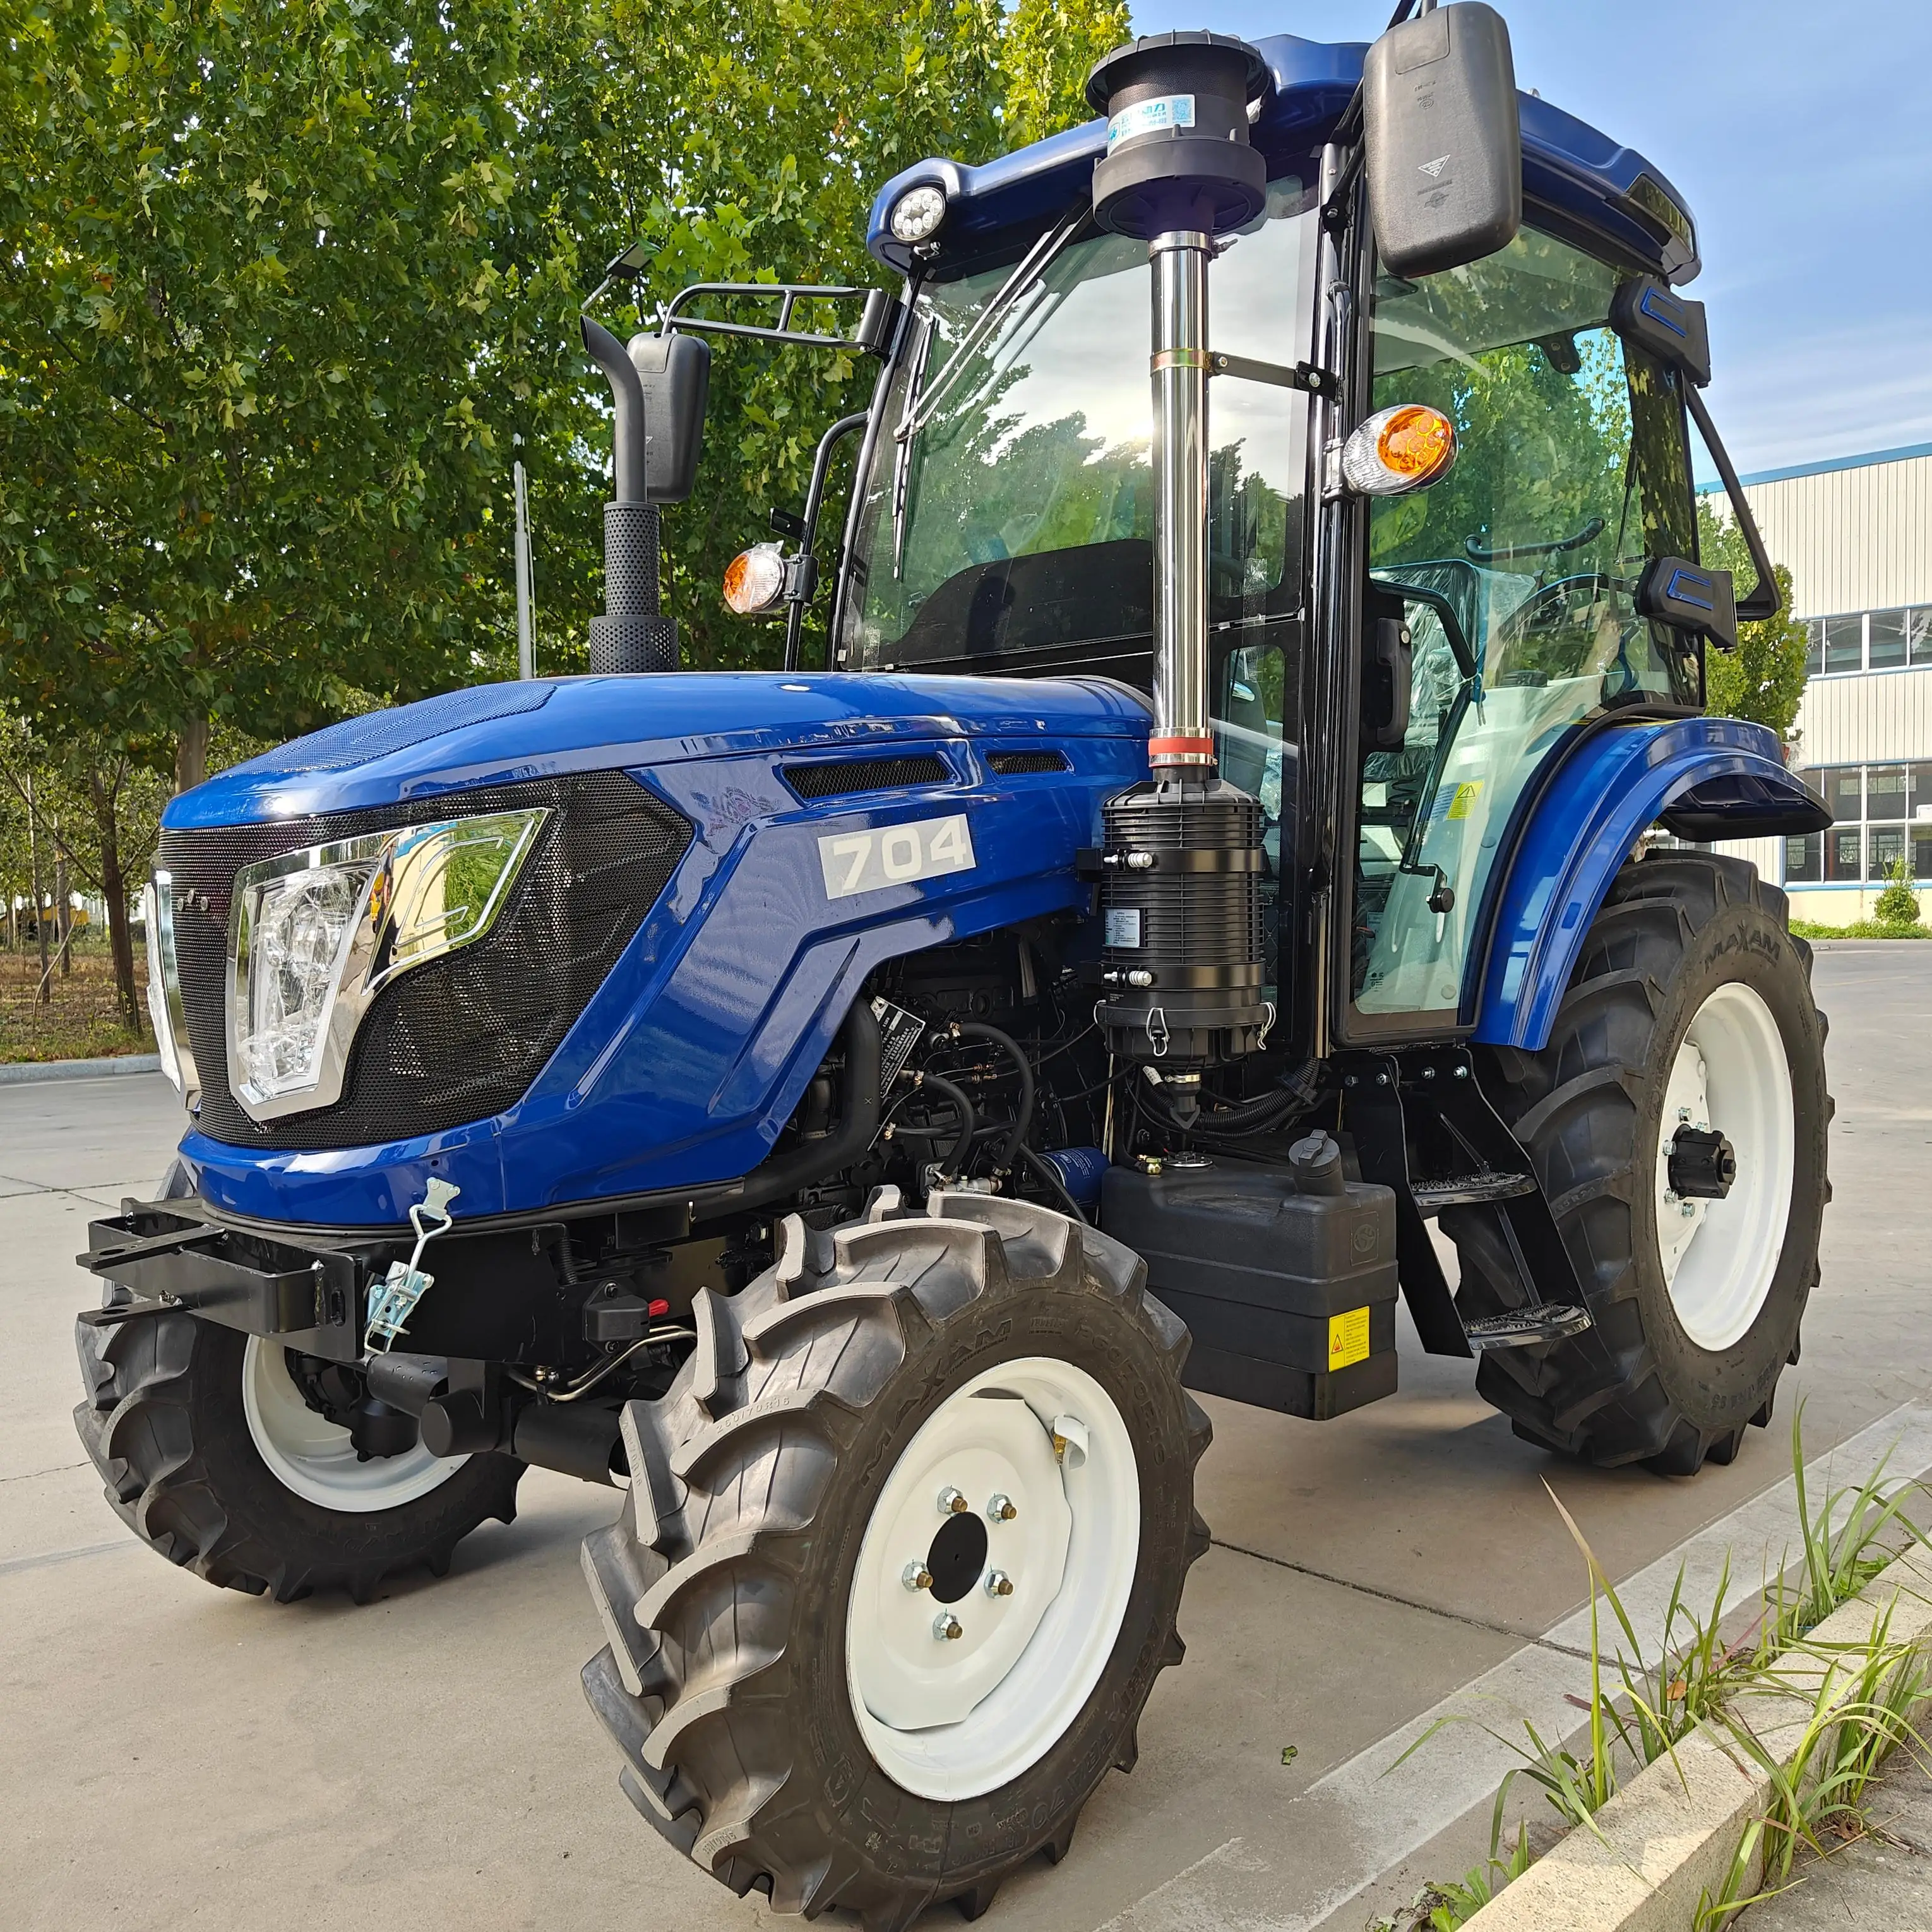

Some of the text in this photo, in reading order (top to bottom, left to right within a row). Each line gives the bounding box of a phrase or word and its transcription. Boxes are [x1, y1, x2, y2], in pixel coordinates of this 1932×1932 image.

[833, 819, 969, 890] 704
[1704, 919, 1780, 974] MAXAM
[860, 1318, 1013, 1488] MAXAM
